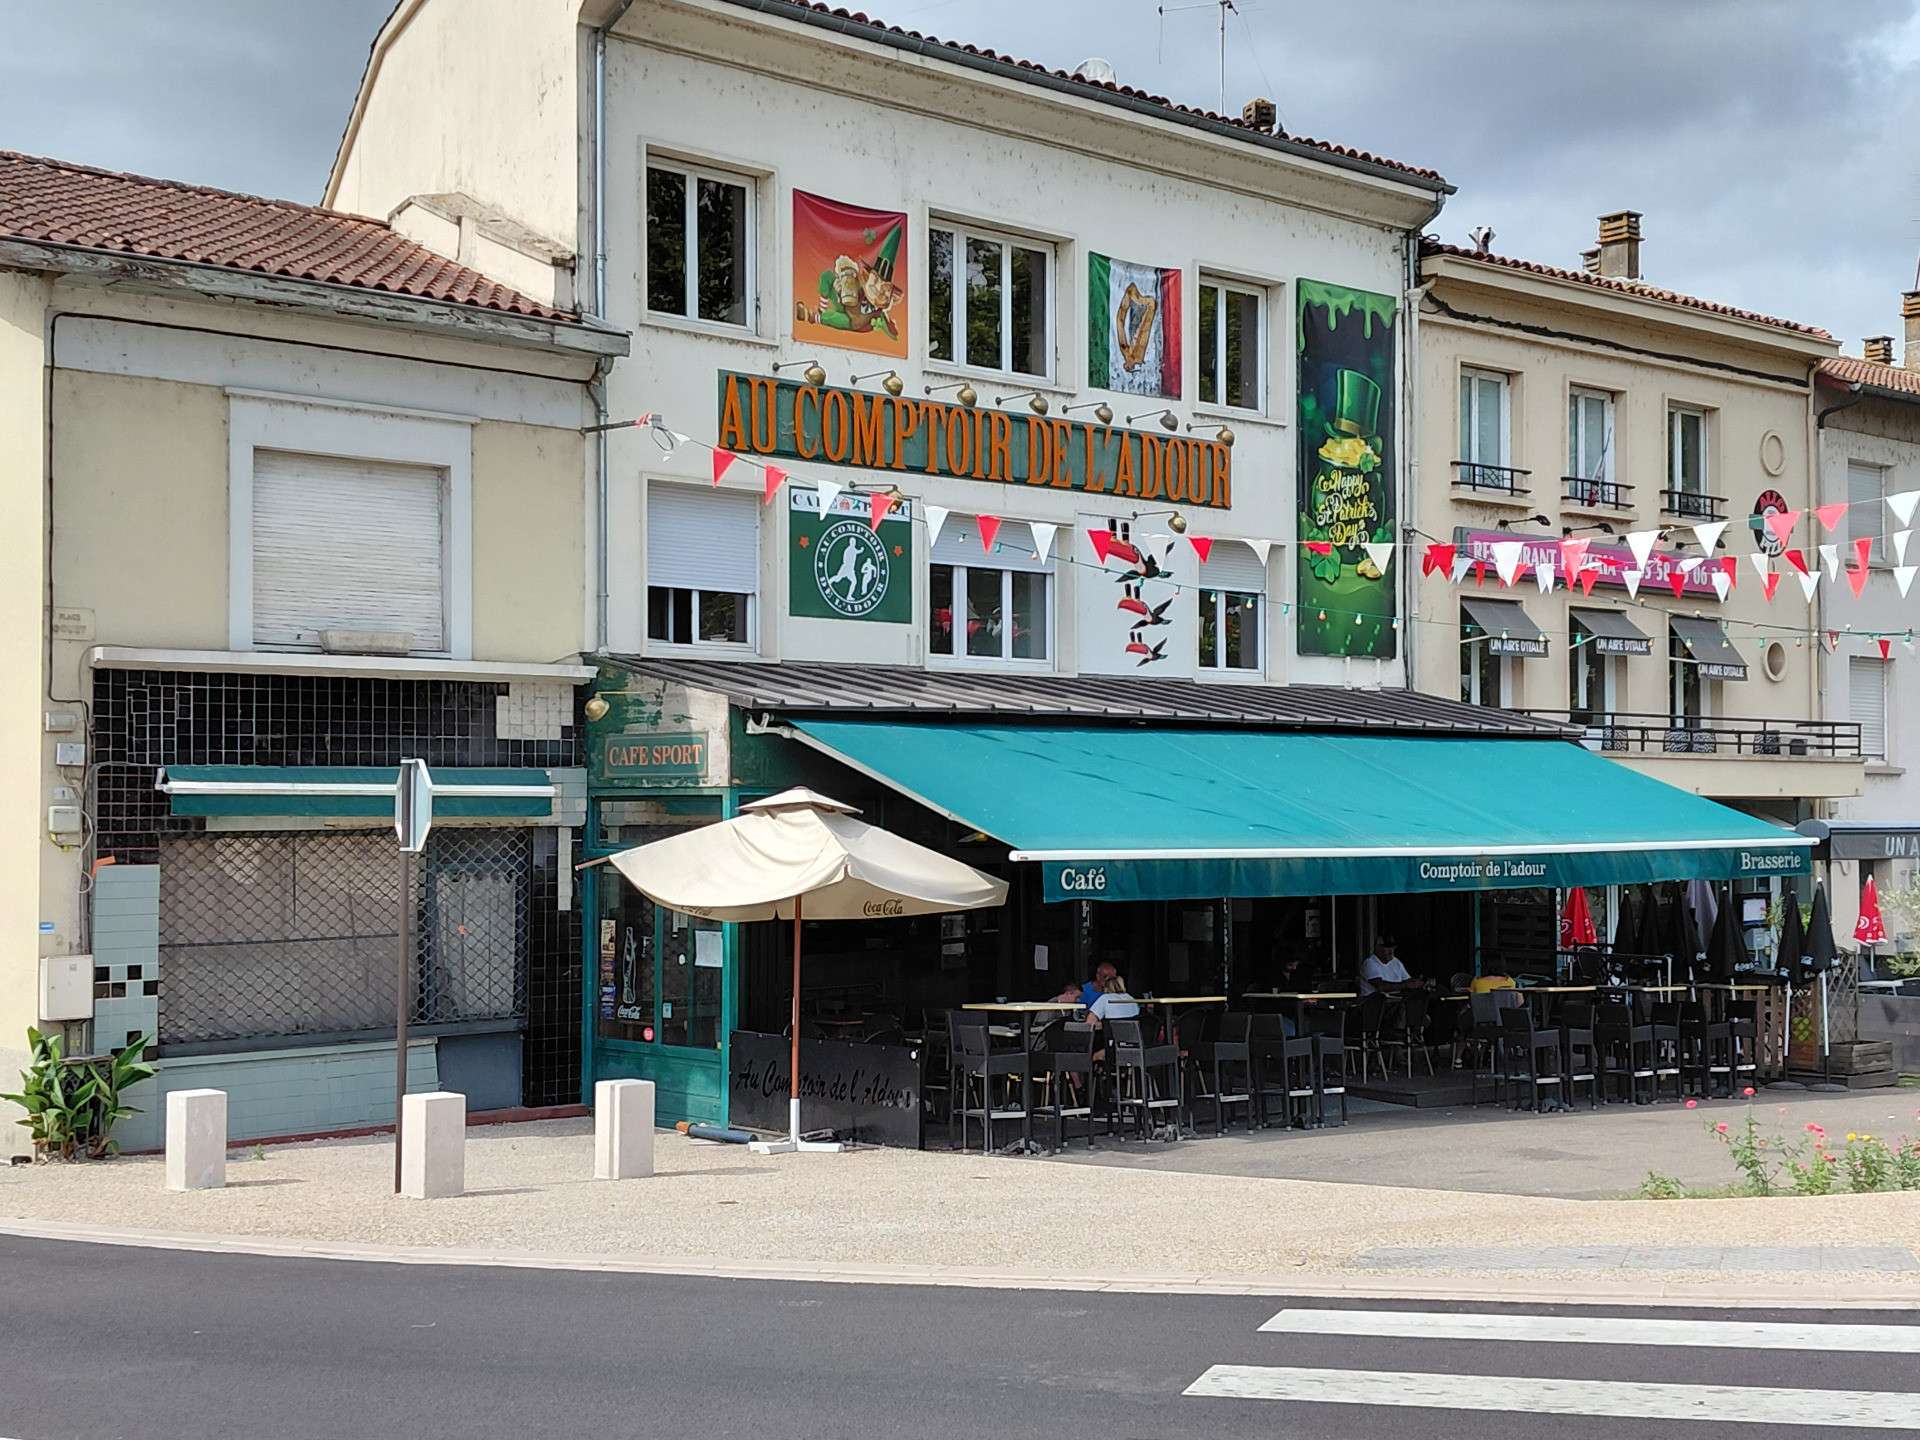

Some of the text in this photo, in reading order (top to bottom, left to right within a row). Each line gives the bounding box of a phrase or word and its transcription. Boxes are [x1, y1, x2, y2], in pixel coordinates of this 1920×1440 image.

[720, 374, 1232, 509] AU COMPTOIR DE L'ADOUR
[1317, 469, 1370, 500] Happy
[609, 744, 703, 766] CAFE SPORT
[1885, 836, 1906, 856] UN
[1420, 860, 1547, 882] Comptoir de l'adour
[1740, 851, 1801, 870] Brasserie
[1061, 866, 1106, 890] Café
[735, 1060, 760, 1091] Au
[762, 1060, 827, 1098] Comtoir
[829, 1073, 848, 1101] de
